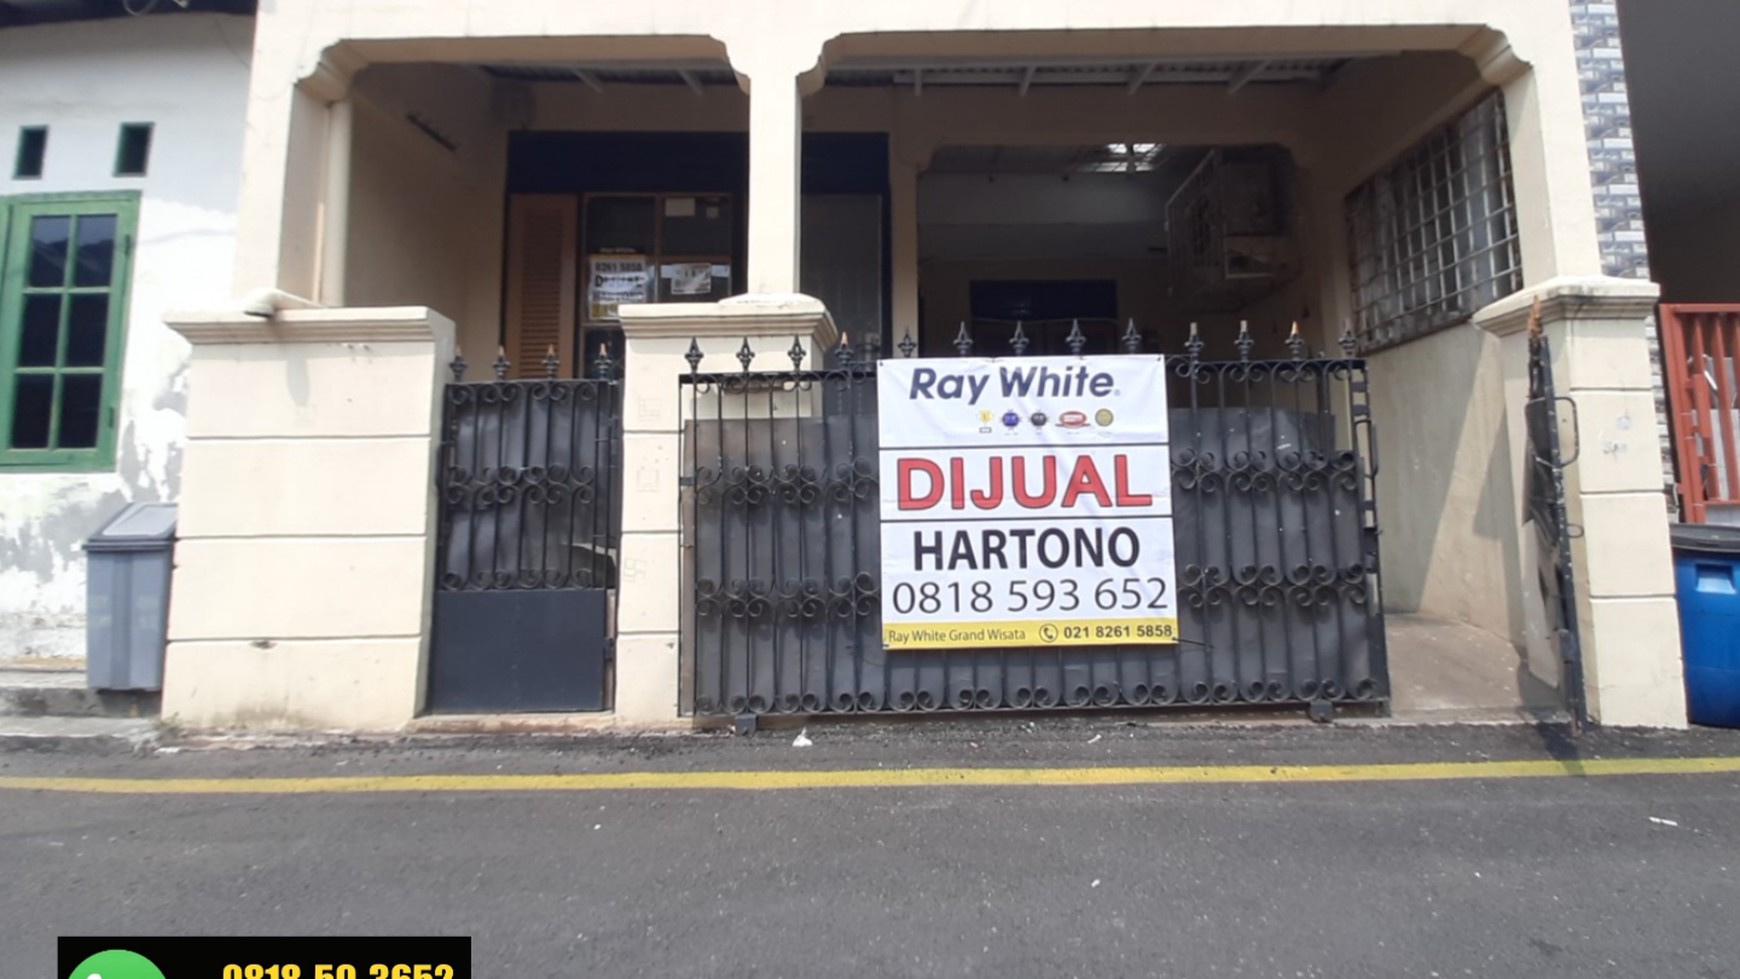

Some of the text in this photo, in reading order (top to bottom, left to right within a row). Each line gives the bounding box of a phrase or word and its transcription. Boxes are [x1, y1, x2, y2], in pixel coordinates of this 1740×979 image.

[910, 365, 1114, 406] Ray White
[897, 454, 1153, 511] DIJUAL
[913, 527, 1140, 571] HARTONO
[892, 577, 1168, 614] 0818 593 652
[888, 624, 1173, 644] Ray White Grand Wisata 021 8261 5858
